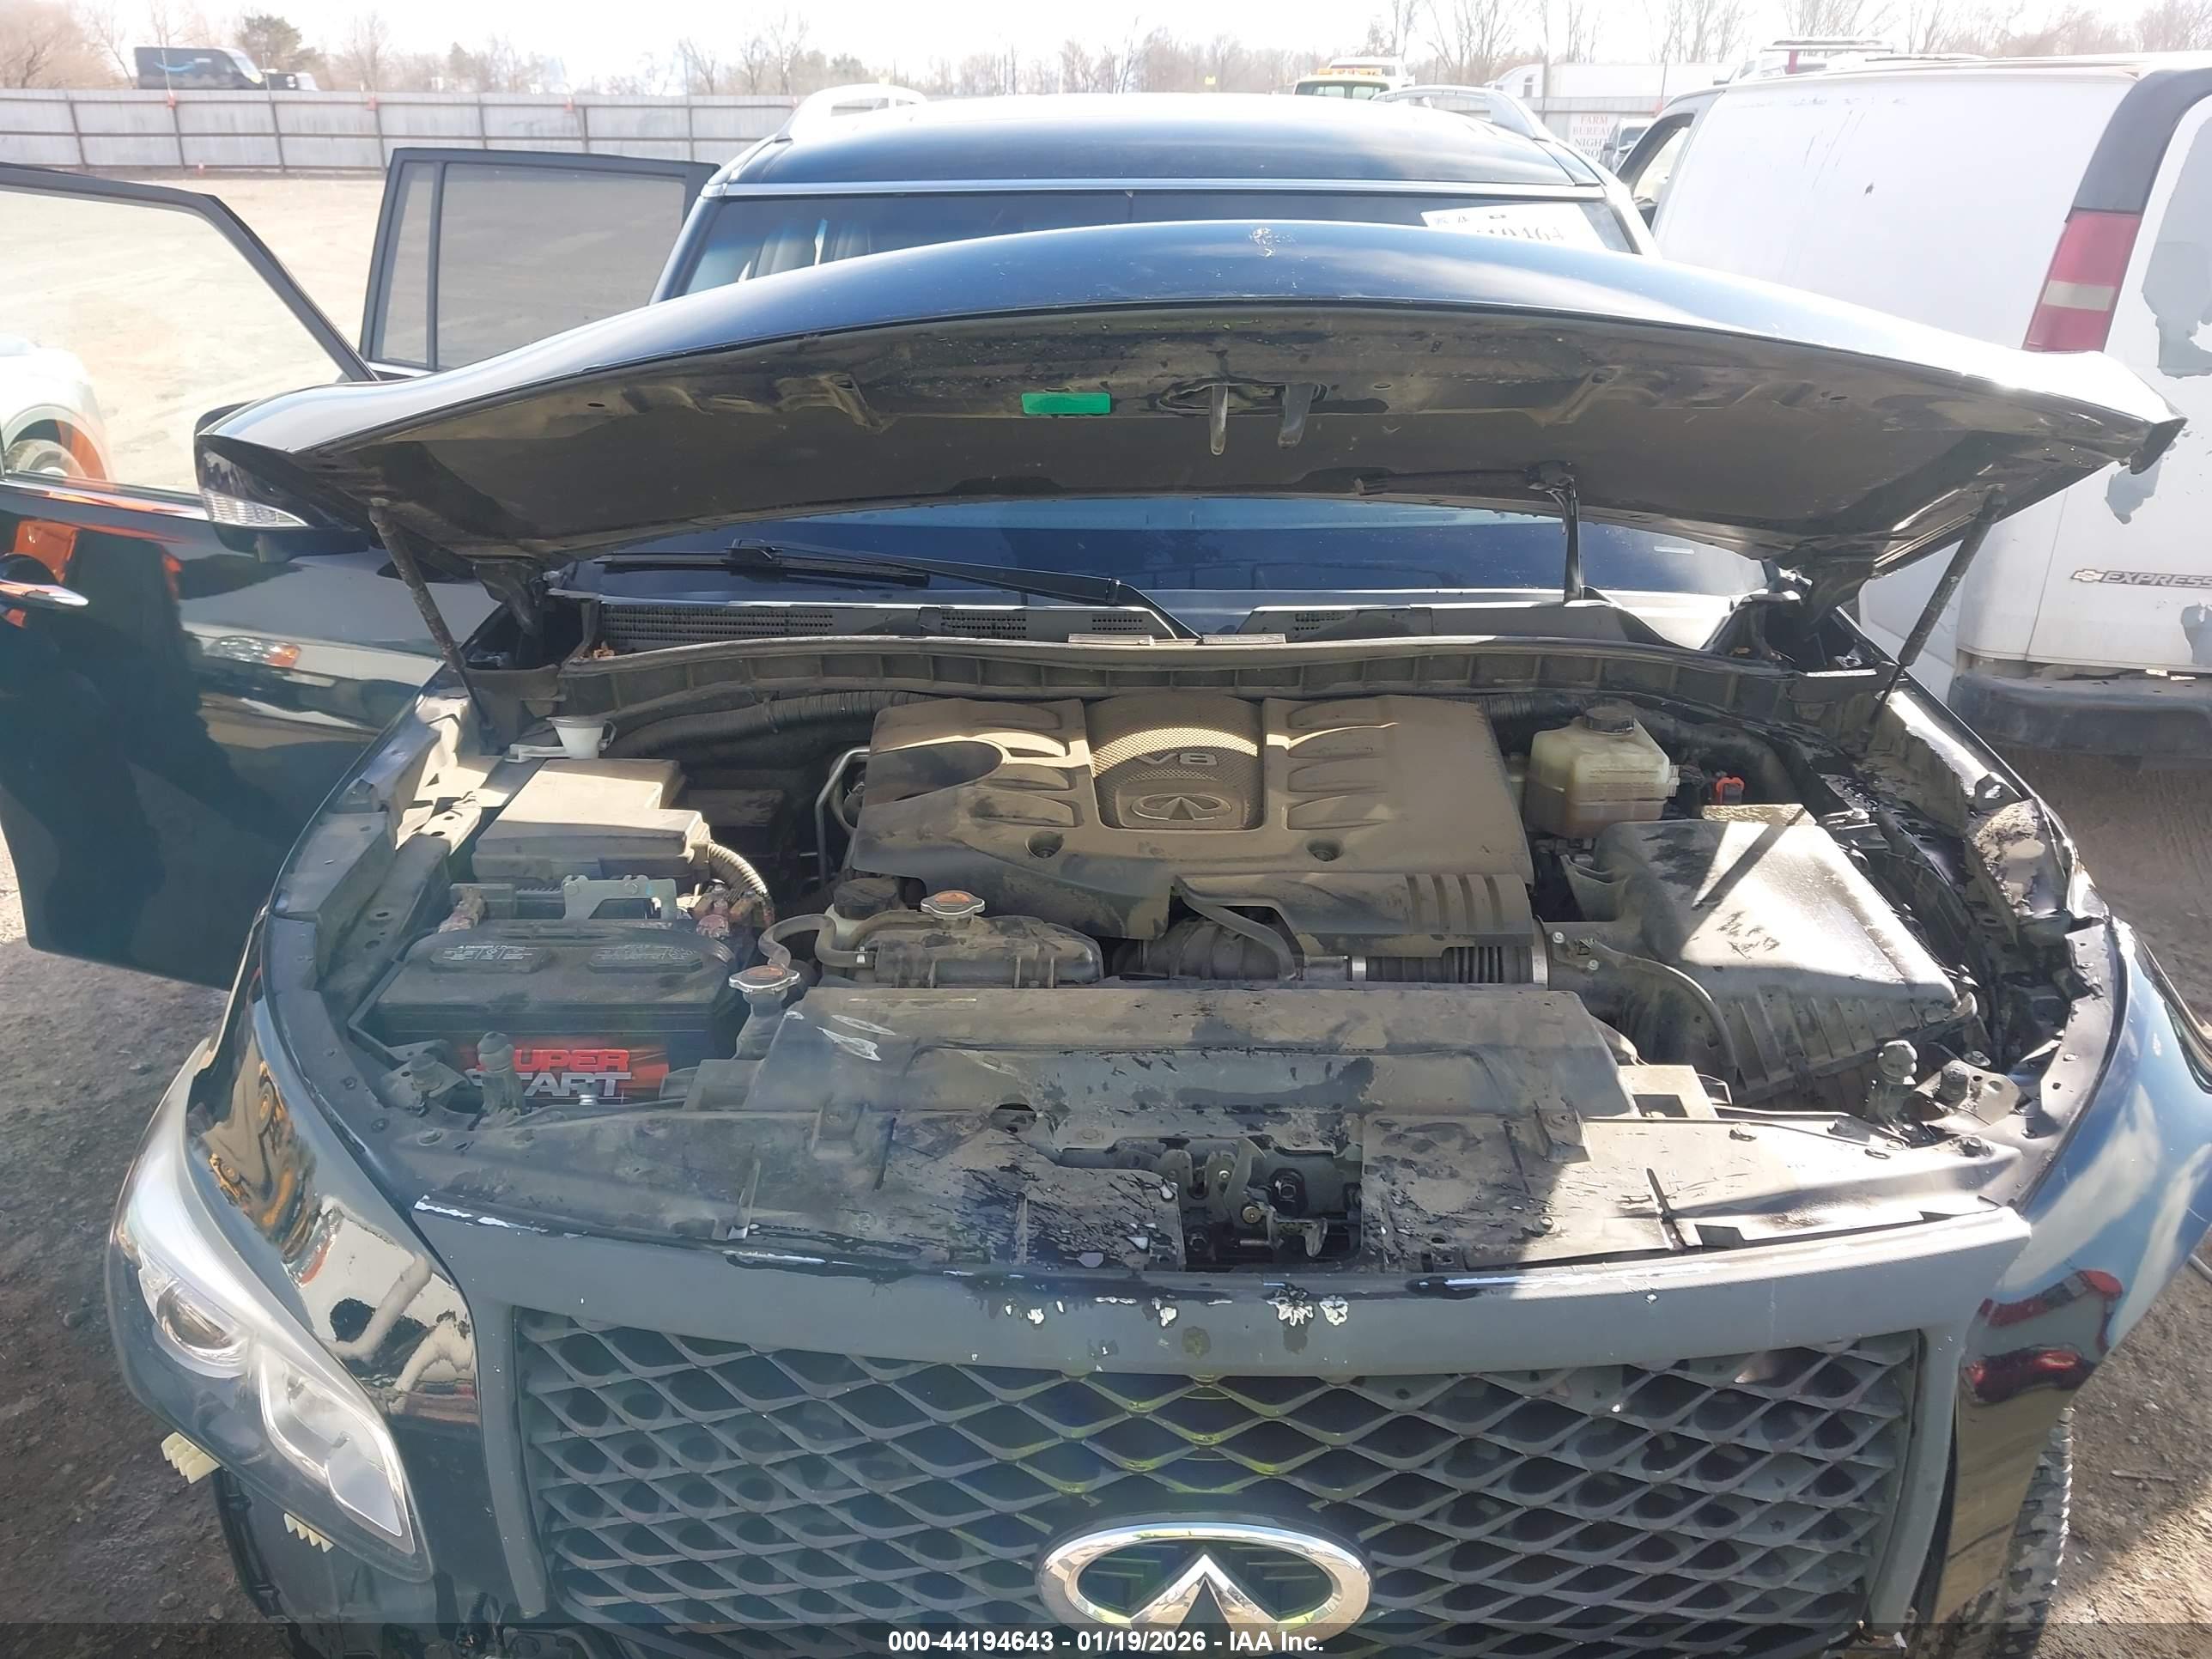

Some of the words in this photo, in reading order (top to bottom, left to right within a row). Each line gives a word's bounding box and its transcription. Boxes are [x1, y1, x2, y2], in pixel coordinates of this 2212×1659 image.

[1580, 116, 1608, 125] FARM
[2104, 571, 2212, 588] EXPRESS
[1134, 752, 1218, 766] V8
[476, 1048, 630, 1073] UPER
